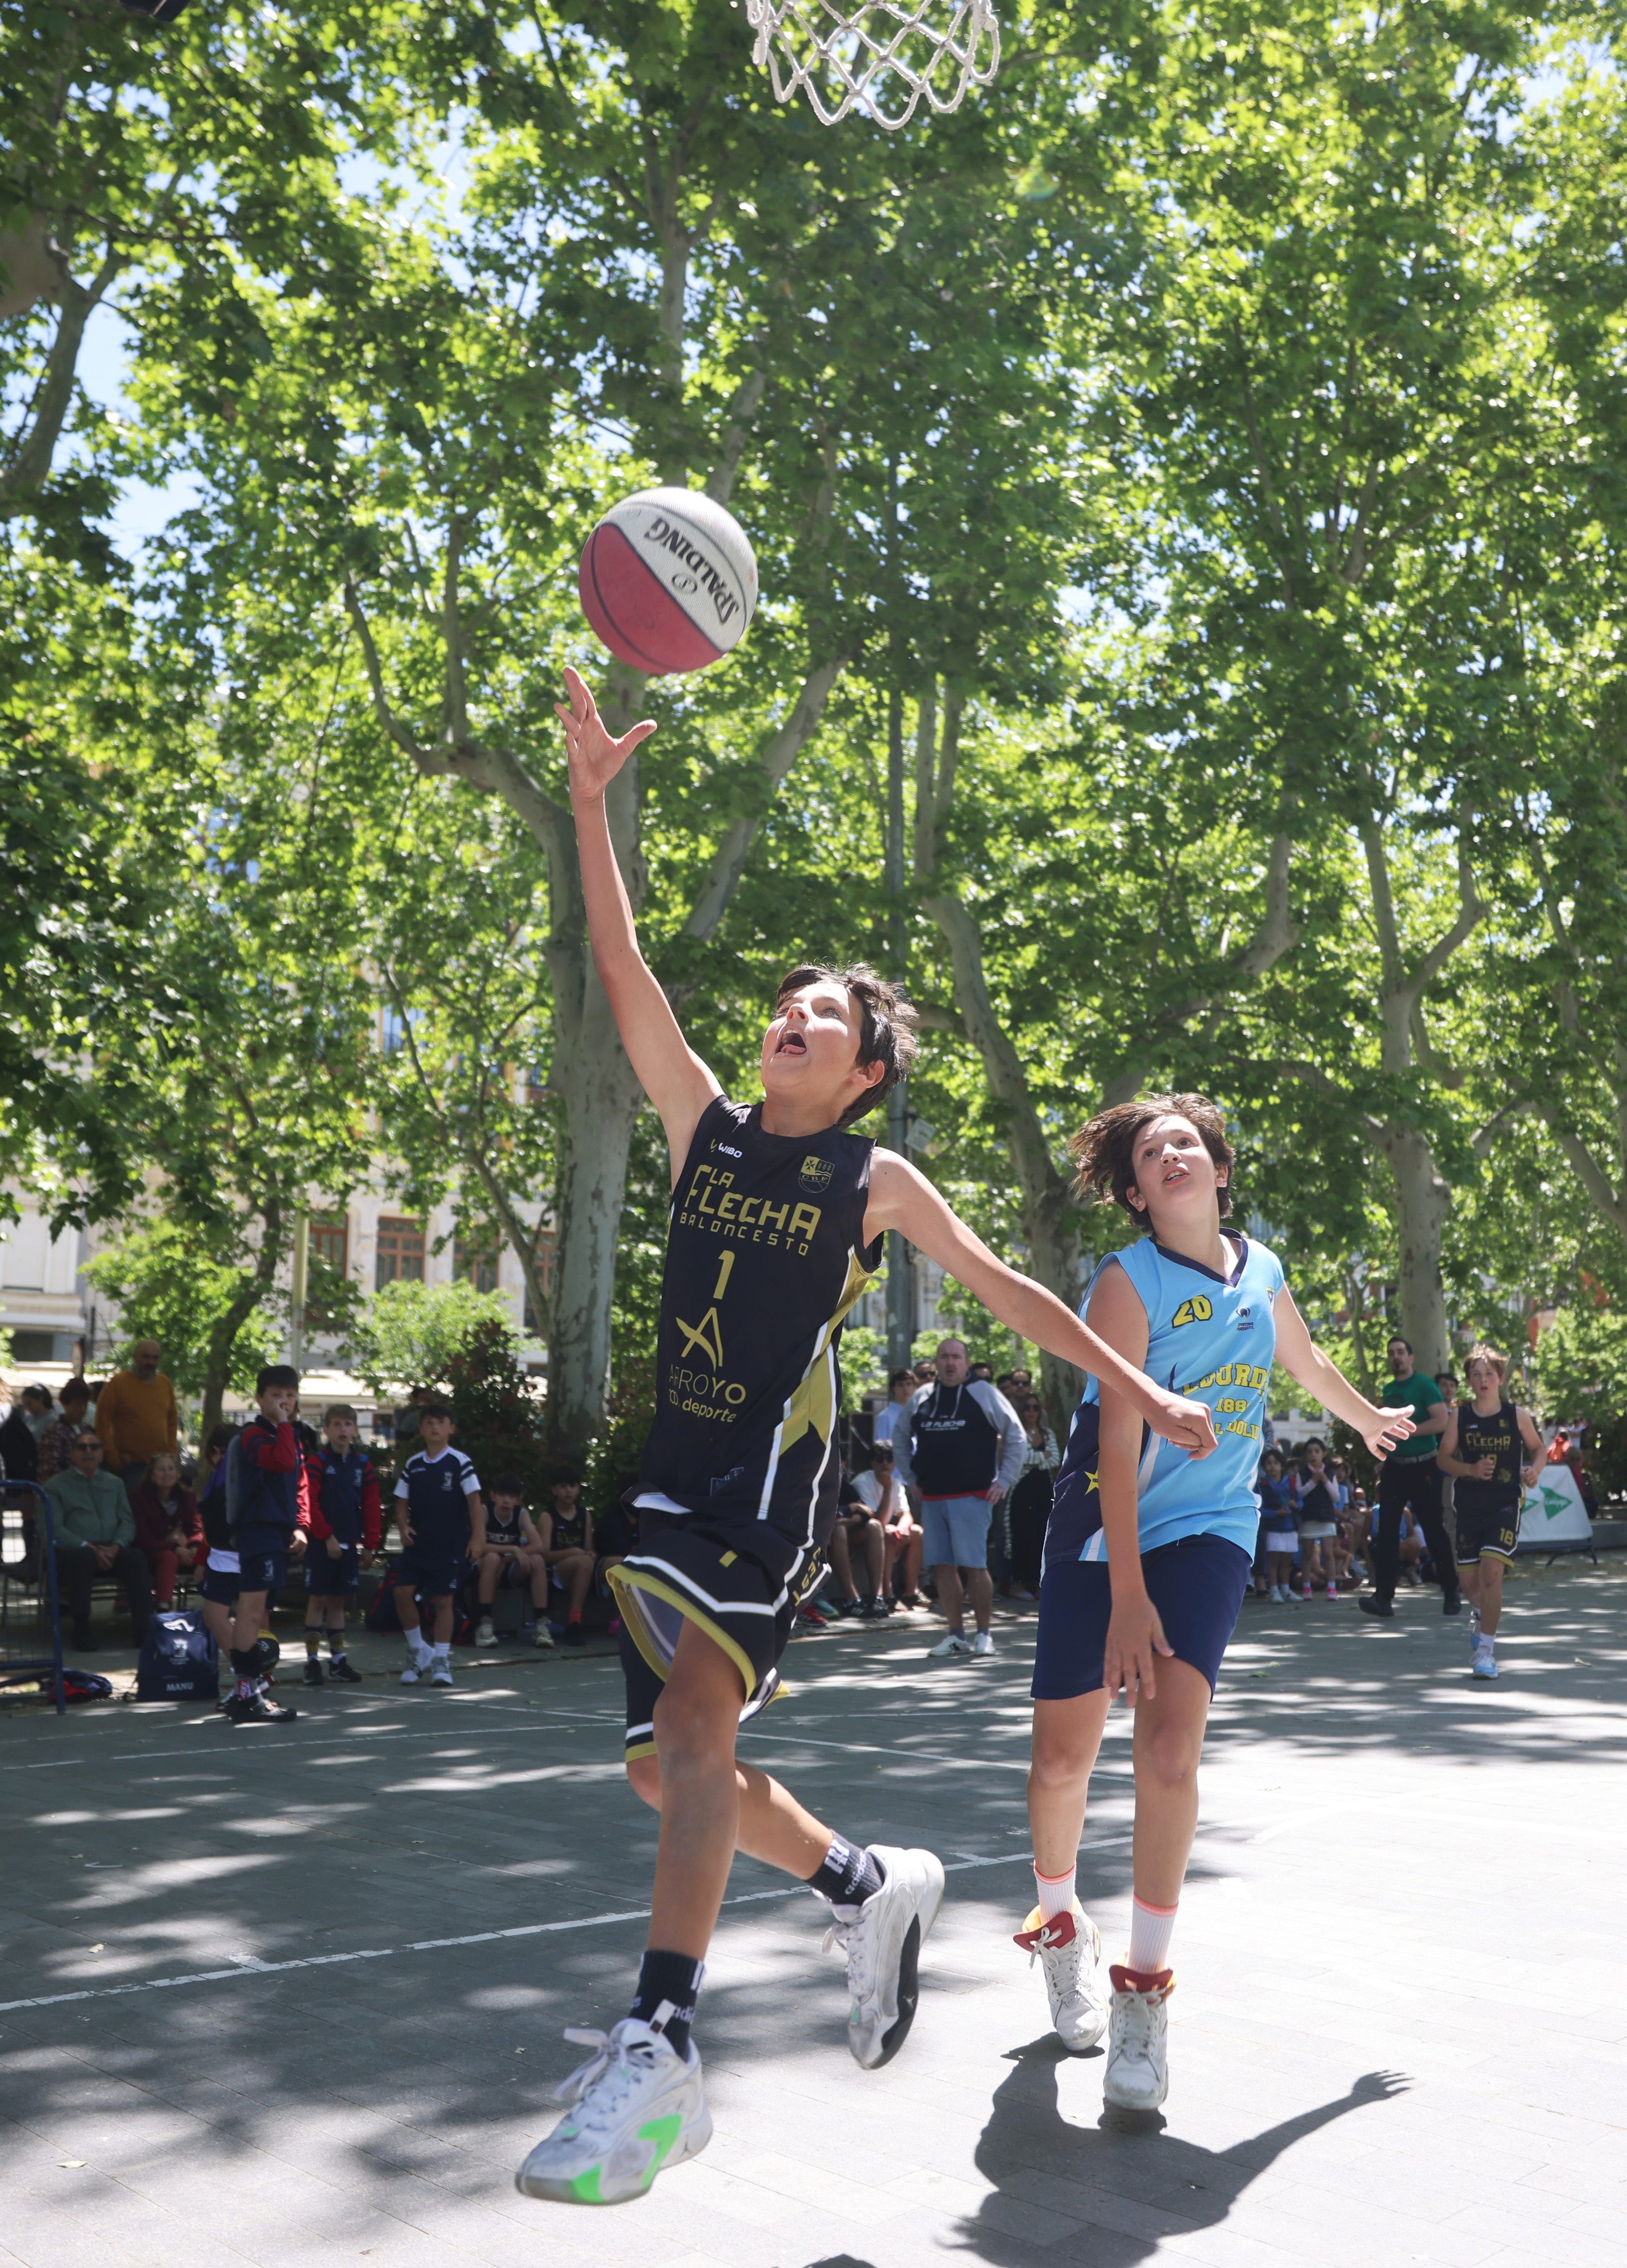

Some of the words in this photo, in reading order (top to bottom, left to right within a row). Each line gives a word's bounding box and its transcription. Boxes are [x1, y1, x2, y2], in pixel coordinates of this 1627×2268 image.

[644, 517, 739, 624] SPALDING
[718, 1143, 743, 1158] WIBO
[709, 1168, 735, 1188] LA
[684, 1165, 822, 1240] FLECHA
[680, 1212, 809, 1256] BALONCESTO
[713, 1250, 735, 1299] 1
[1172, 1294, 1213, 1329] 20
[682, 1398, 737, 1423] deporte
[1215, 1398, 1250, 1413] 188
[1466, 1433, 1511, 1447] FLECHA
[1500, 1528, 1514, 1547] 18
[166, 1682, 194, 1691] MANU
[844, 1851, 867, 1895] adidas
